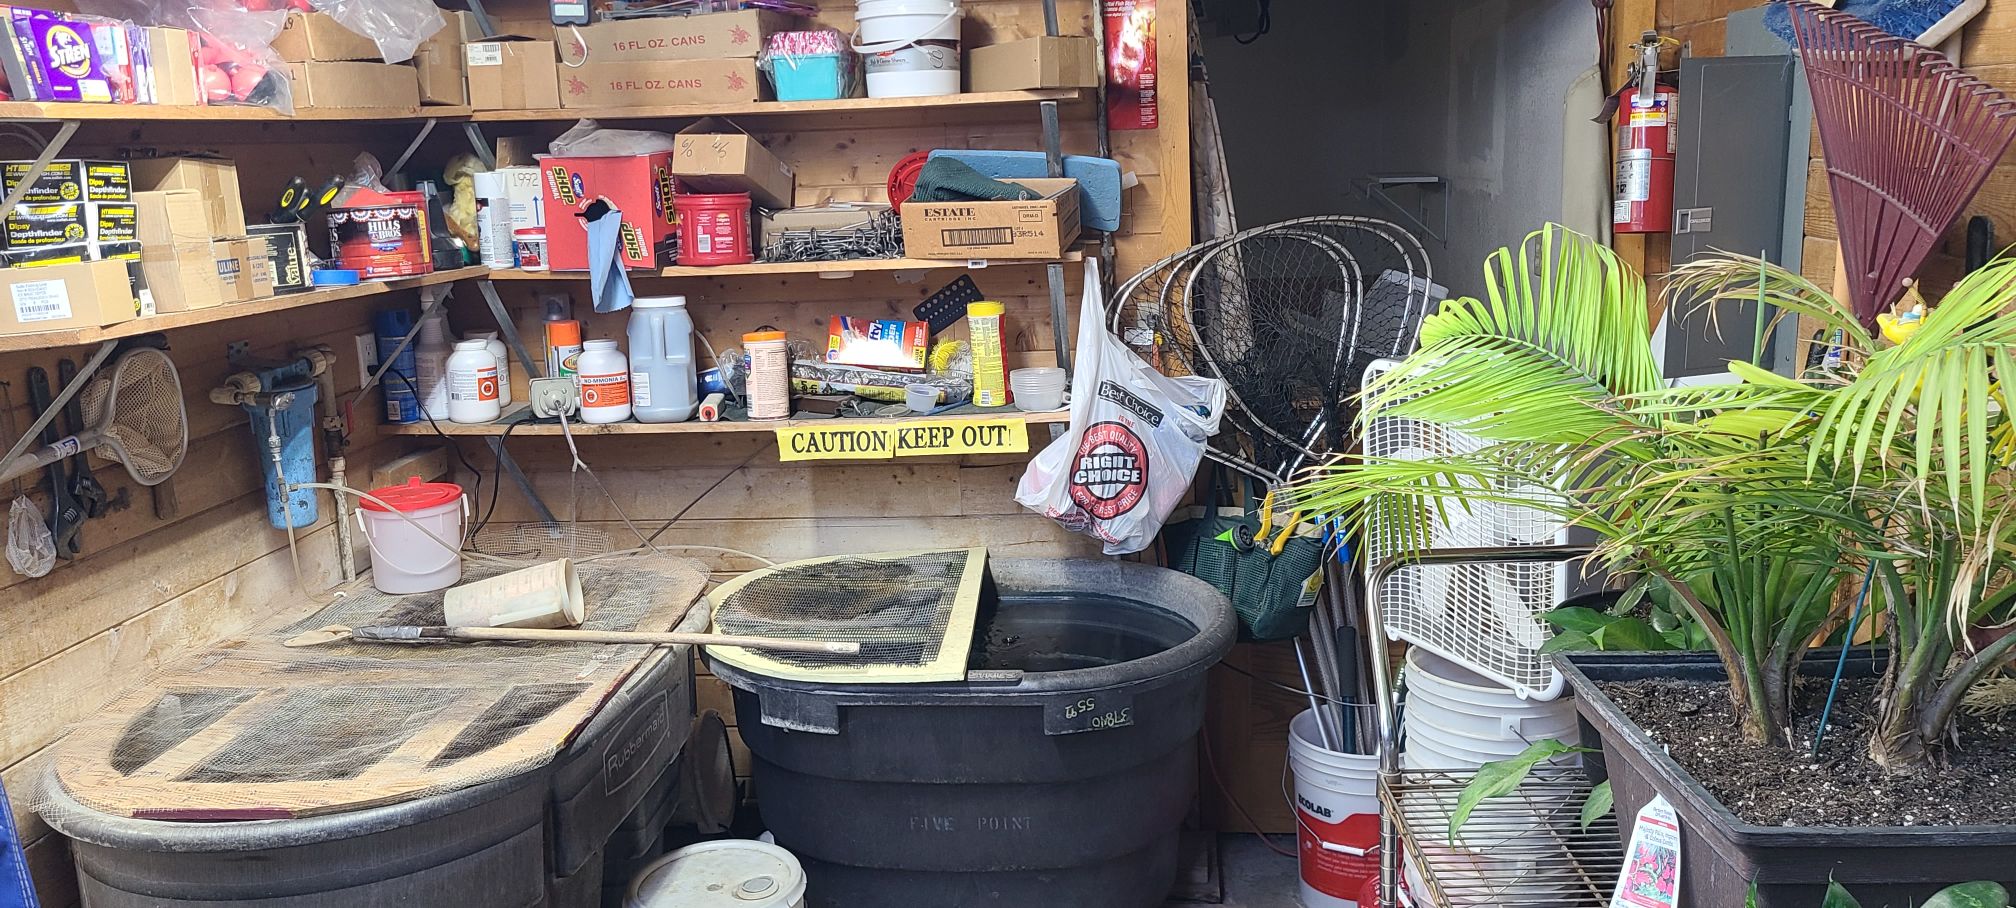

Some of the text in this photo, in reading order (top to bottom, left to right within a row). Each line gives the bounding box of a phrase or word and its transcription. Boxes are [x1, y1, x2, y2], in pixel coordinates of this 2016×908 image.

[612, 34, 706, 51] 16 FL. OZ. CANS
[50, 43, 91, 68] STREN
[610, 78, 702, 90] 16 FL. OZ. CANS
[513, 172, 539, 187] 1992
[545, 170, 561, 200] ORIGINAL
[552, 166, 576, 206] SHOP
[658, 167, 677, 225] SHOP
[924, 207, 976, 217] ESTATE
[10, 230, 64, 239] Depthfinder
[368, 220, 401, 232] HILLS
[620, 222, 643, 261] SHOP
[217, 260, 240, 274] ULINE
[1101, 383, 1125, 403] Best
[791, 425, 1012, 454] CAUTION! KEEP OUT!
[1089, 430, 1110, 444] BEST
[1109, 431, 1138, 454] QUALITY
[1080, 455, 1136, 470] RIGHT
[1073, 469, 1141, 484] CHOICE
[1117, 489, 1138, 509] PRICE
[607, 701, 666, 778] Rubbermaid
[1298, 793, 1332, 818] ECOLAB
[909, 816, 1032, 831] FIVE POINT
